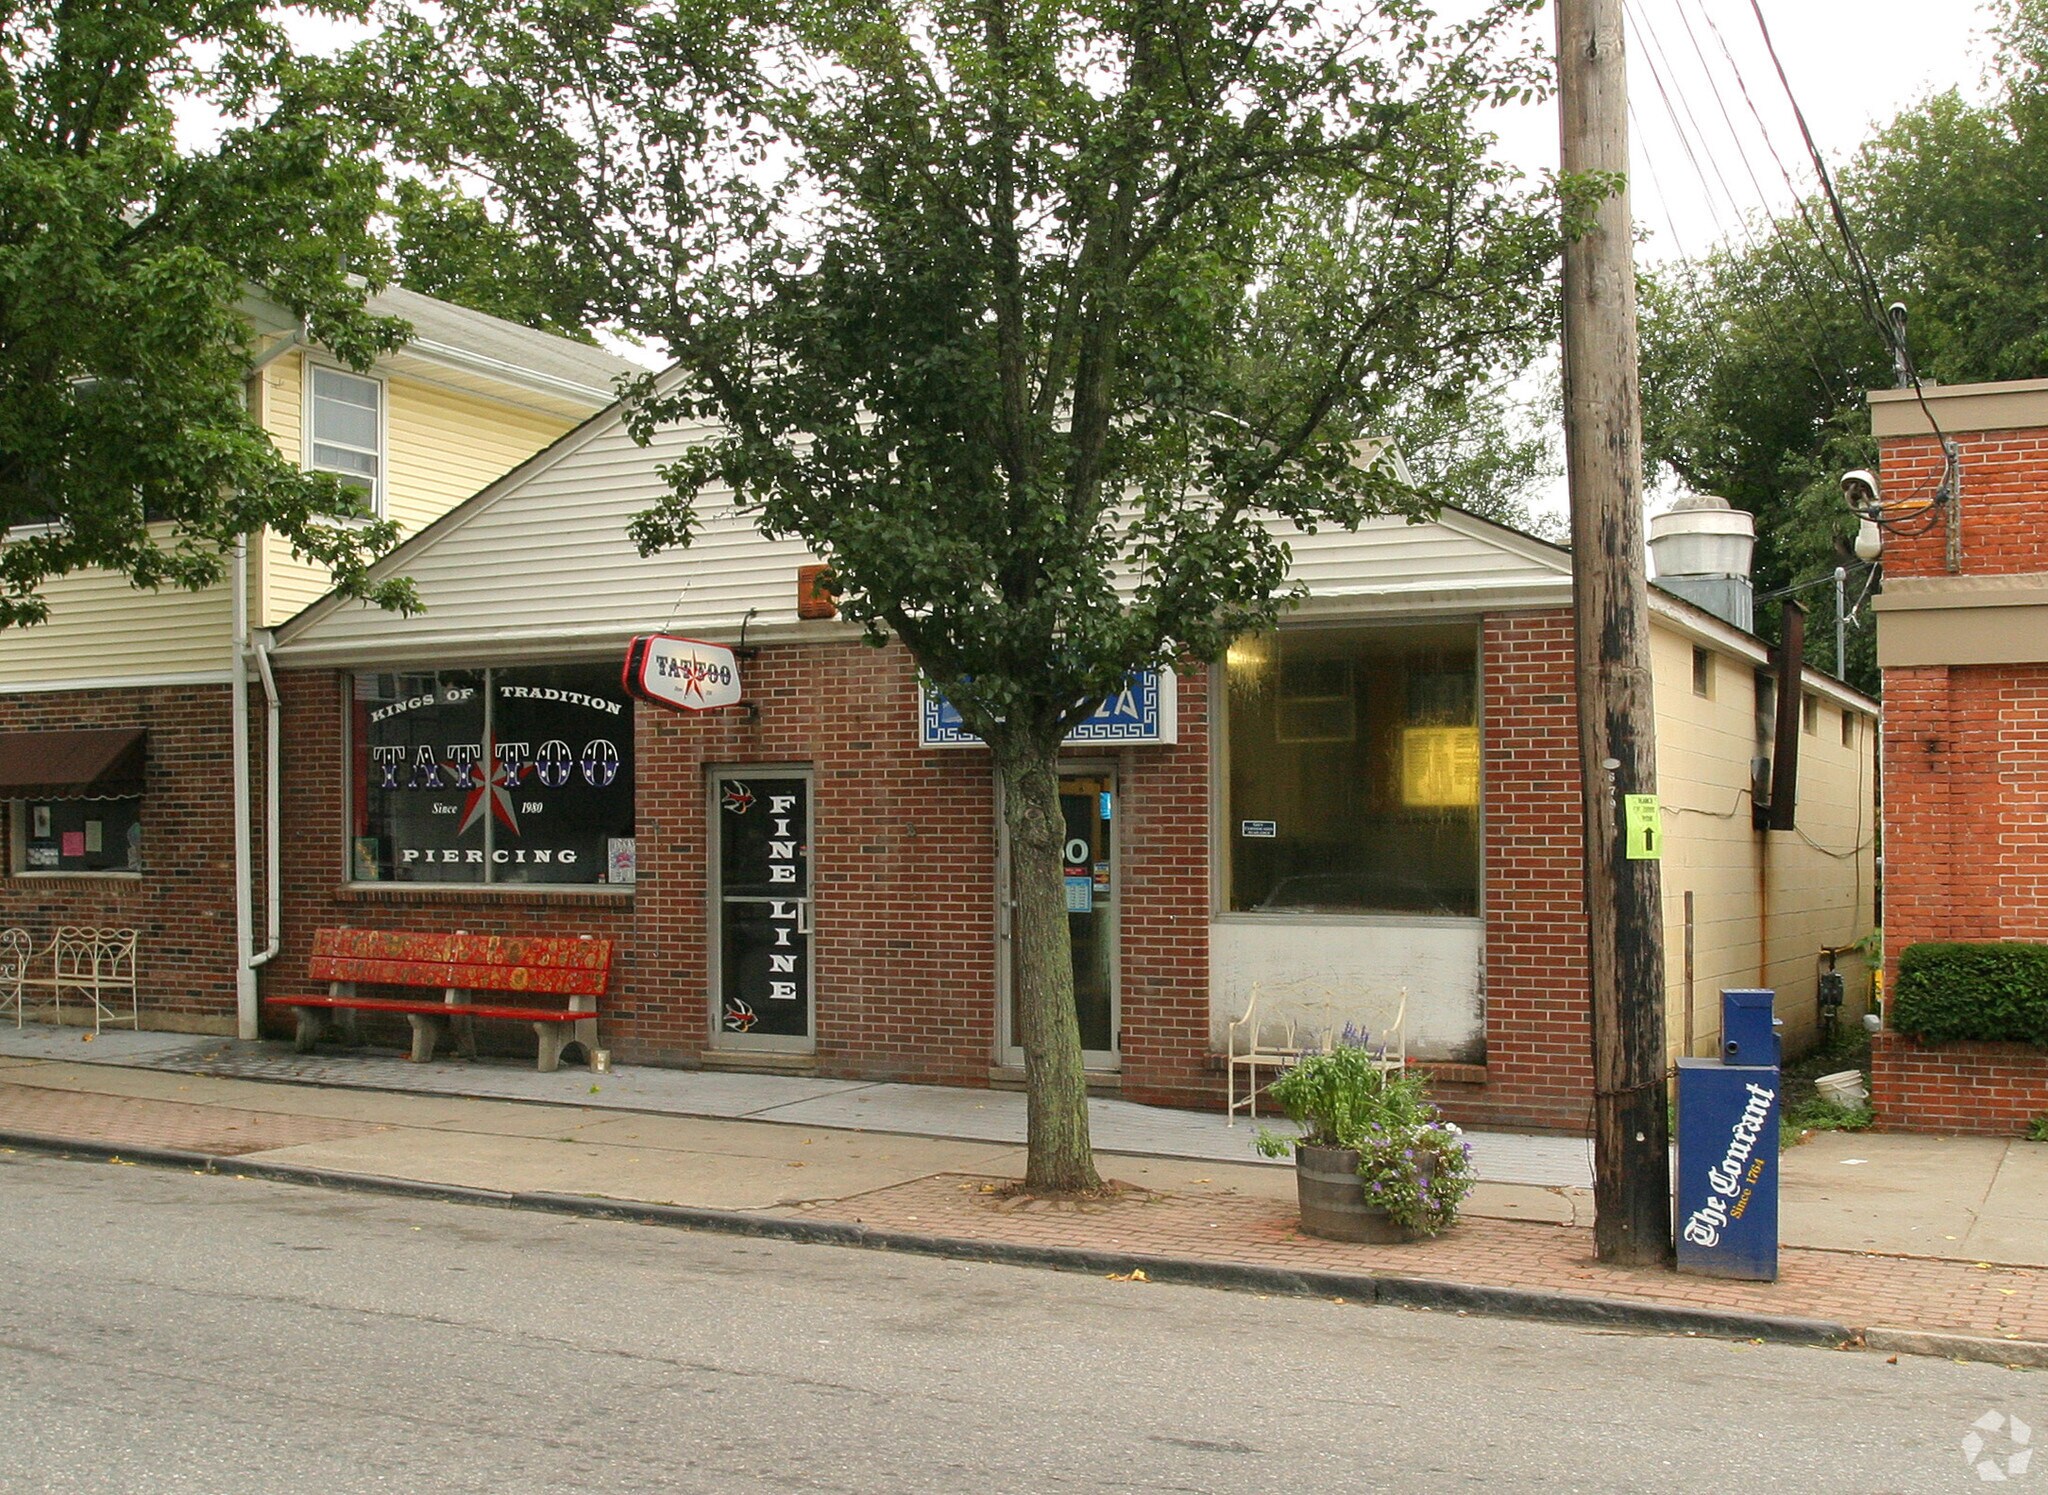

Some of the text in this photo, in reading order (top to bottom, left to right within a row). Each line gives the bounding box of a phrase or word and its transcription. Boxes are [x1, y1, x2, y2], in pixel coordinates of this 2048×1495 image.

[656, 655, 731, 686] TATTOO
[370, 686, 622, 722] KINGS OF TRADITION
[373, 739, 619, 787] TATTOO
[432, 802, 543, 814] Since 1980
[402, 849, 577, 863] PIERCING
[768, 795, 798, 999] FINE LINE
[1684, 1082, 1775, 1247] The Courant
[1730, 1157, 1765, 1220] Since 1764
